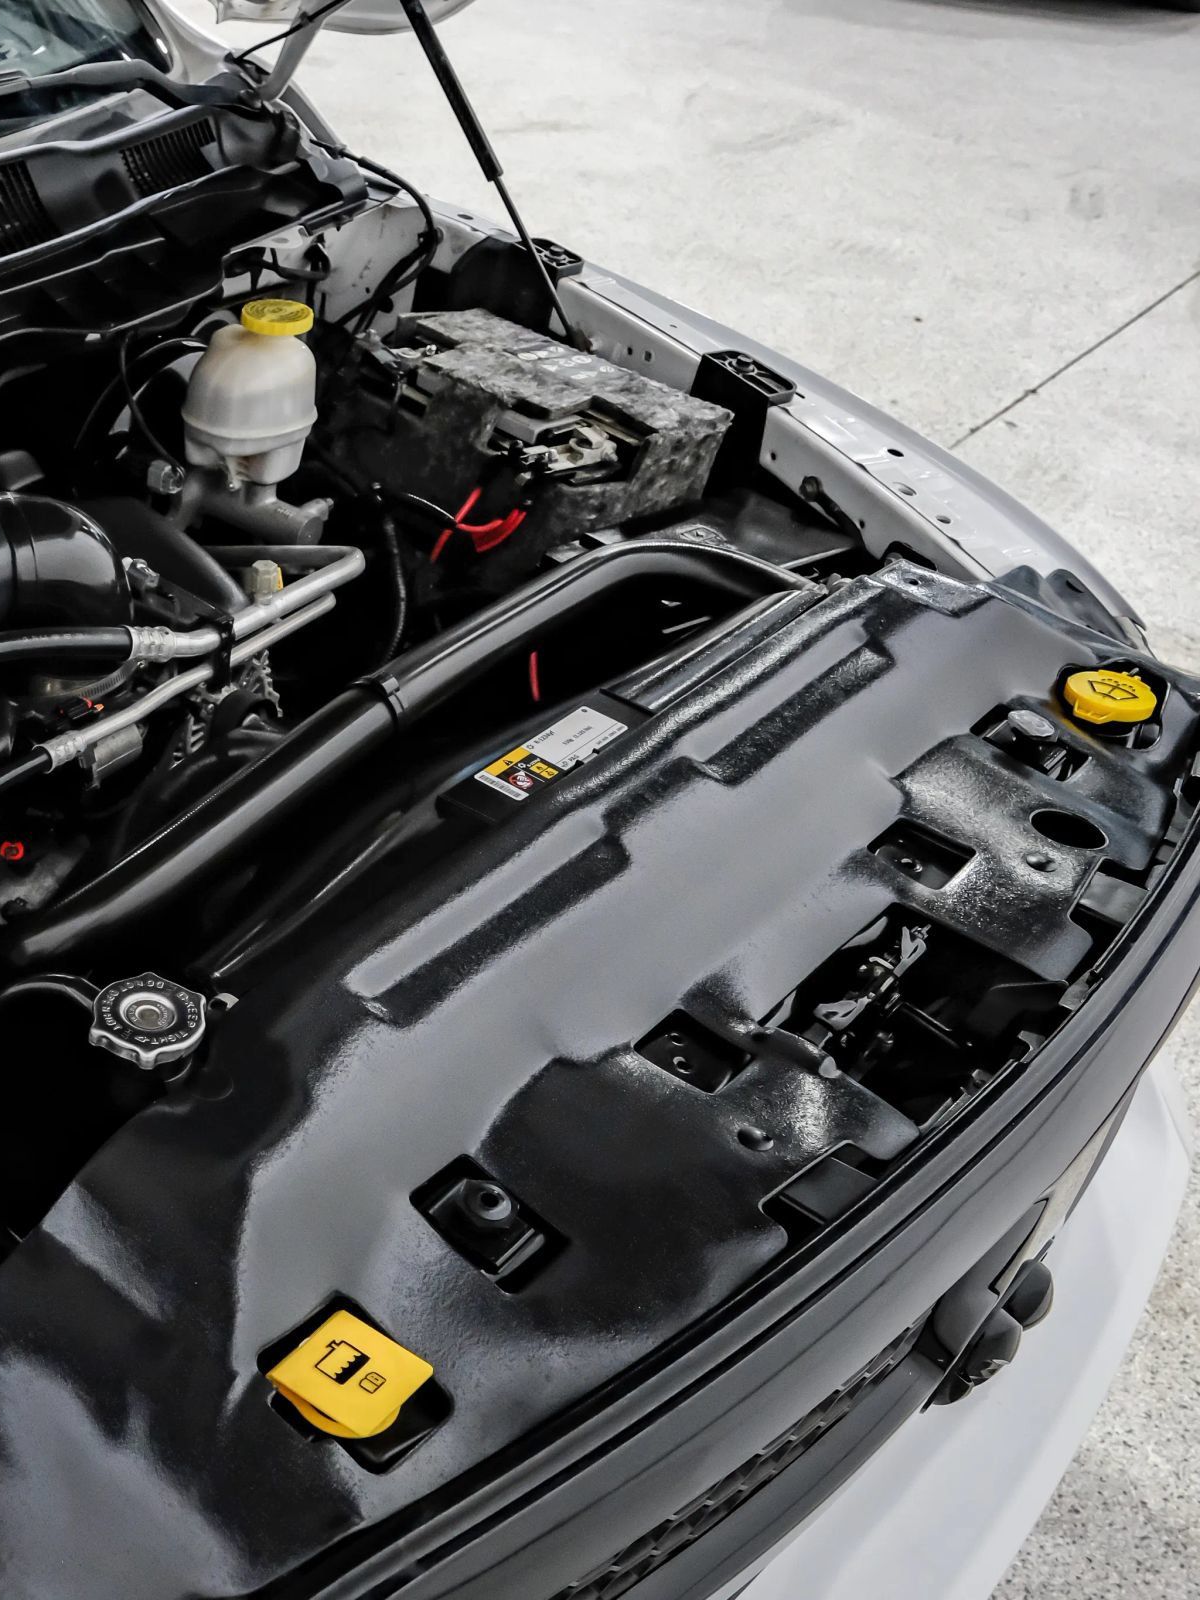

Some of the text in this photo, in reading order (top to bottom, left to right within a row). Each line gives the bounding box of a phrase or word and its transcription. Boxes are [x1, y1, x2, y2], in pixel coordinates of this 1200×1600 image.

[568, 754, 579, 762] PAG
[185, 1001, 198, 1028] KEEP
[151, 1030, 189, 1045] TIGHT
